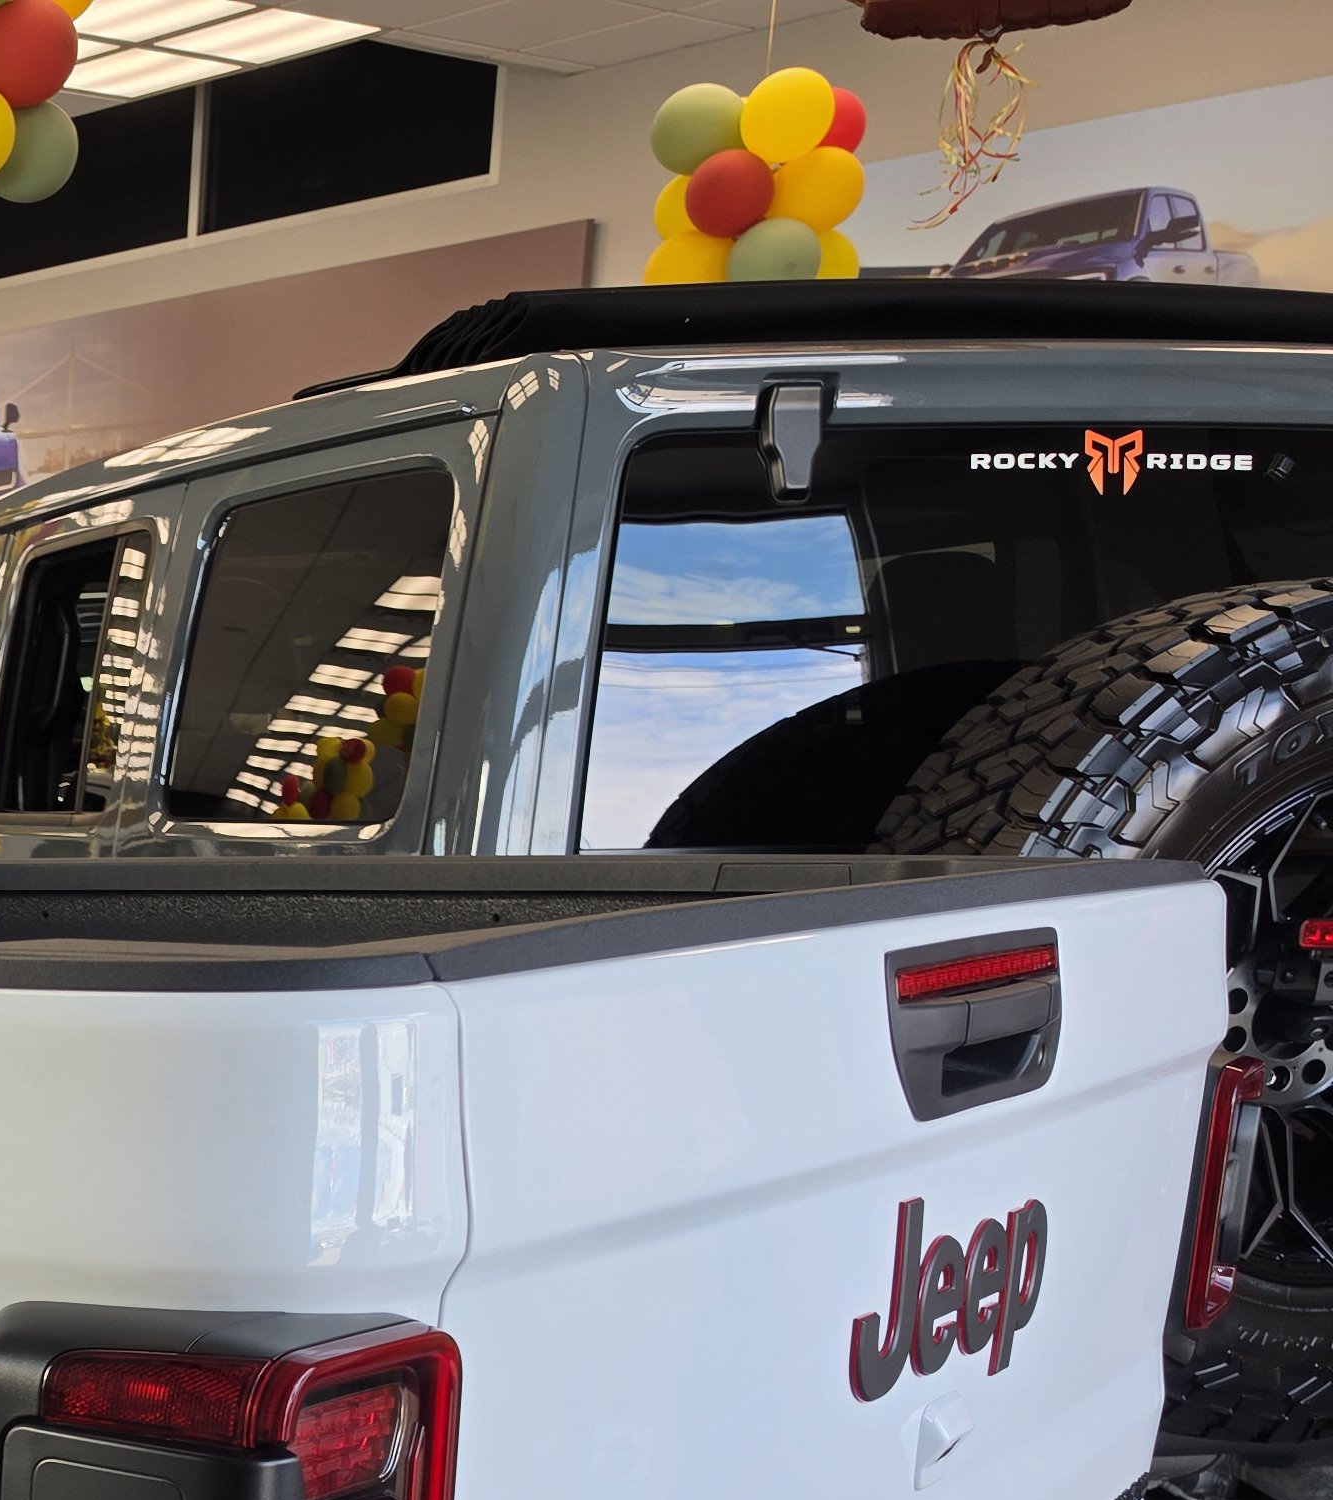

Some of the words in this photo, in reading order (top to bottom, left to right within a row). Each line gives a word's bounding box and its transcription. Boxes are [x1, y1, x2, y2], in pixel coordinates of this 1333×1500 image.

[970, 452, 1080, 470] ROCKY
[1145, 452, 1254, 471] RIDGE
[849, 1197, 1048, 1402] Jeep
